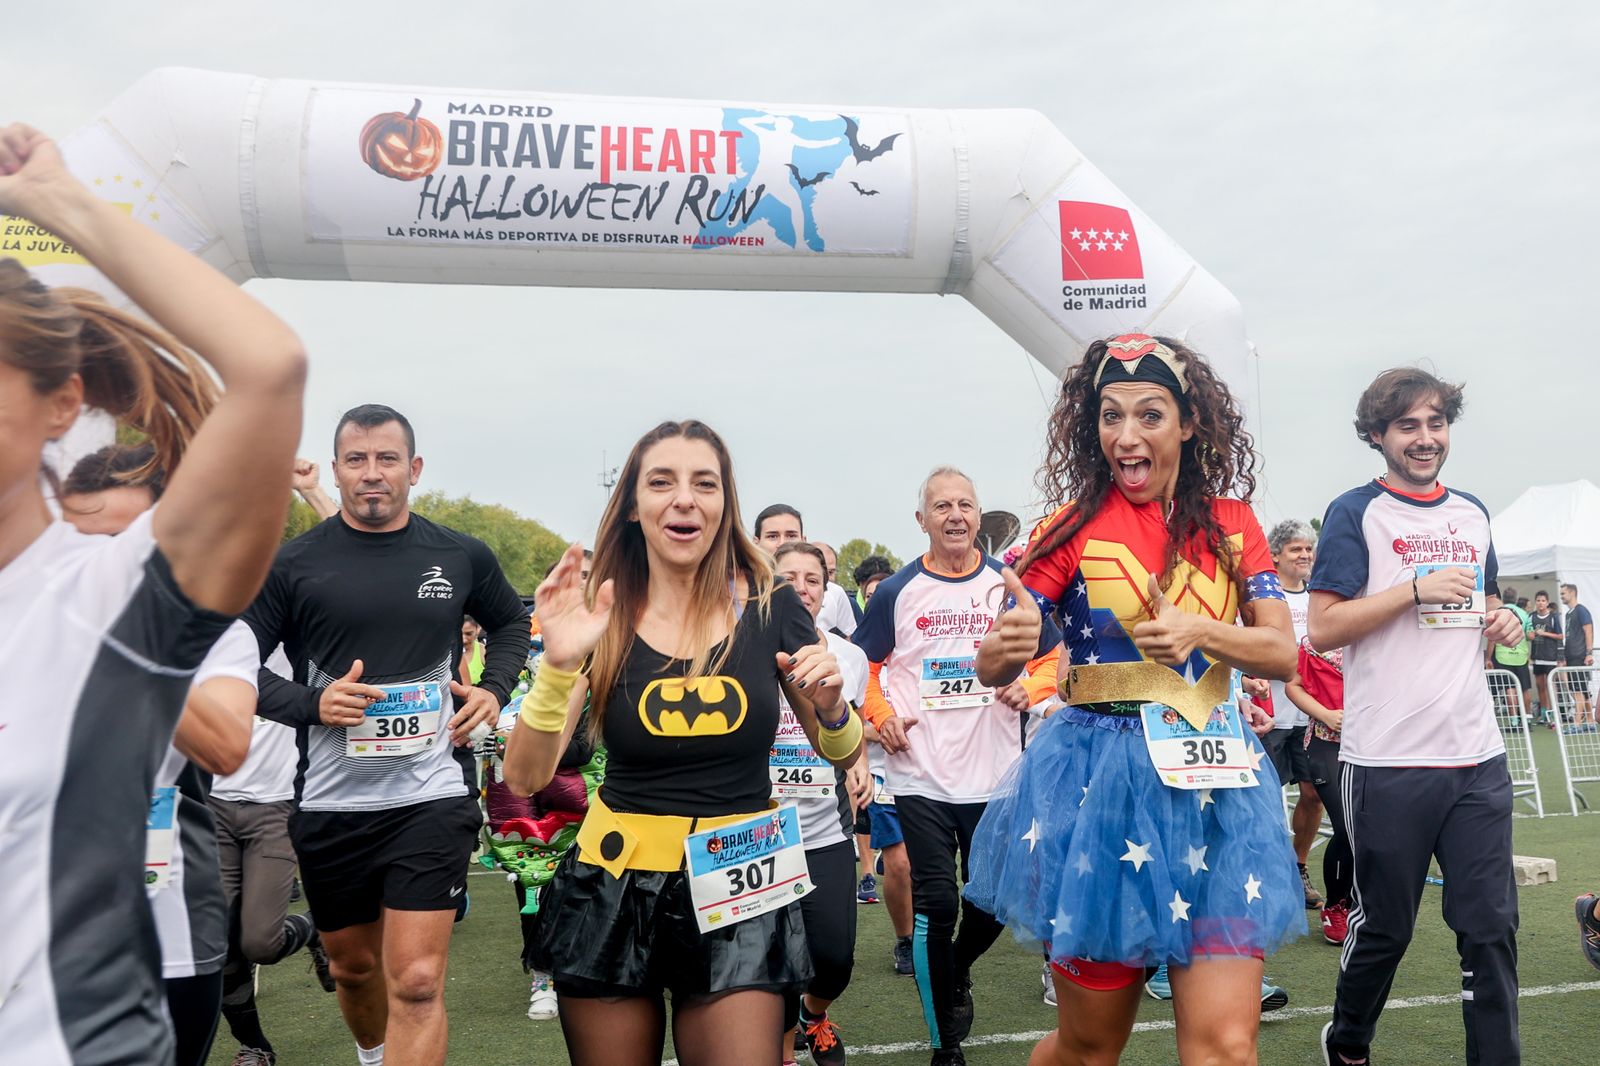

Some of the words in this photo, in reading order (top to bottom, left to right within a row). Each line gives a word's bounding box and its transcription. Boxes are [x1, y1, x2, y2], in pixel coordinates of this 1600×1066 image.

[447, 102, 553, 118] MADRID
[447, 119, 743, 184] BRAVEHEART
[415, 174, 670, 223] HALLOWEEN
[675, 175, 766, 229] RUN
[387, 227, 405, 237] LA
[409, 228, 460, 239] FORMA
[464, 227, 494, 240] MÁS
[498, 230, 578, 242] DEPORTIVA
[582, 232, 599, 242] DE
[603, 233, 679, 244] DISFRUTAR
[683, 235, 764, 246] HALLOWEEN
[2, 240, 21, 250] LA
[27, 240, 76, 255] JUVE
[1062, 283, 1146, 297] Comunidad
[1063, 298, 1083, 310] de
[1089, 296, 1147, 310] Madrid
[1408, 539, 1469, 556] BRAVEHEART
[1402, 553, 1448, 566] HALLOWEEN
[929, 613, 988, 628] BRAVEHEART
[967, 625, 985, 636] RUN
[939, 660, 977, 670] BRAVEHEAR
[940, 679, 974, 695] 247
[376, 715, 420, 738] 308
[776, 748, 815, 757] BRAVEHEAR
[1182, 739, 1227, 765] 305
[777, 768, 813, 784] 246
[722, 819, 780, 850] BRAVEHEART
[713, 840, 761, 866] HALLOWEEN
[726, 856, 776, 896] 307
